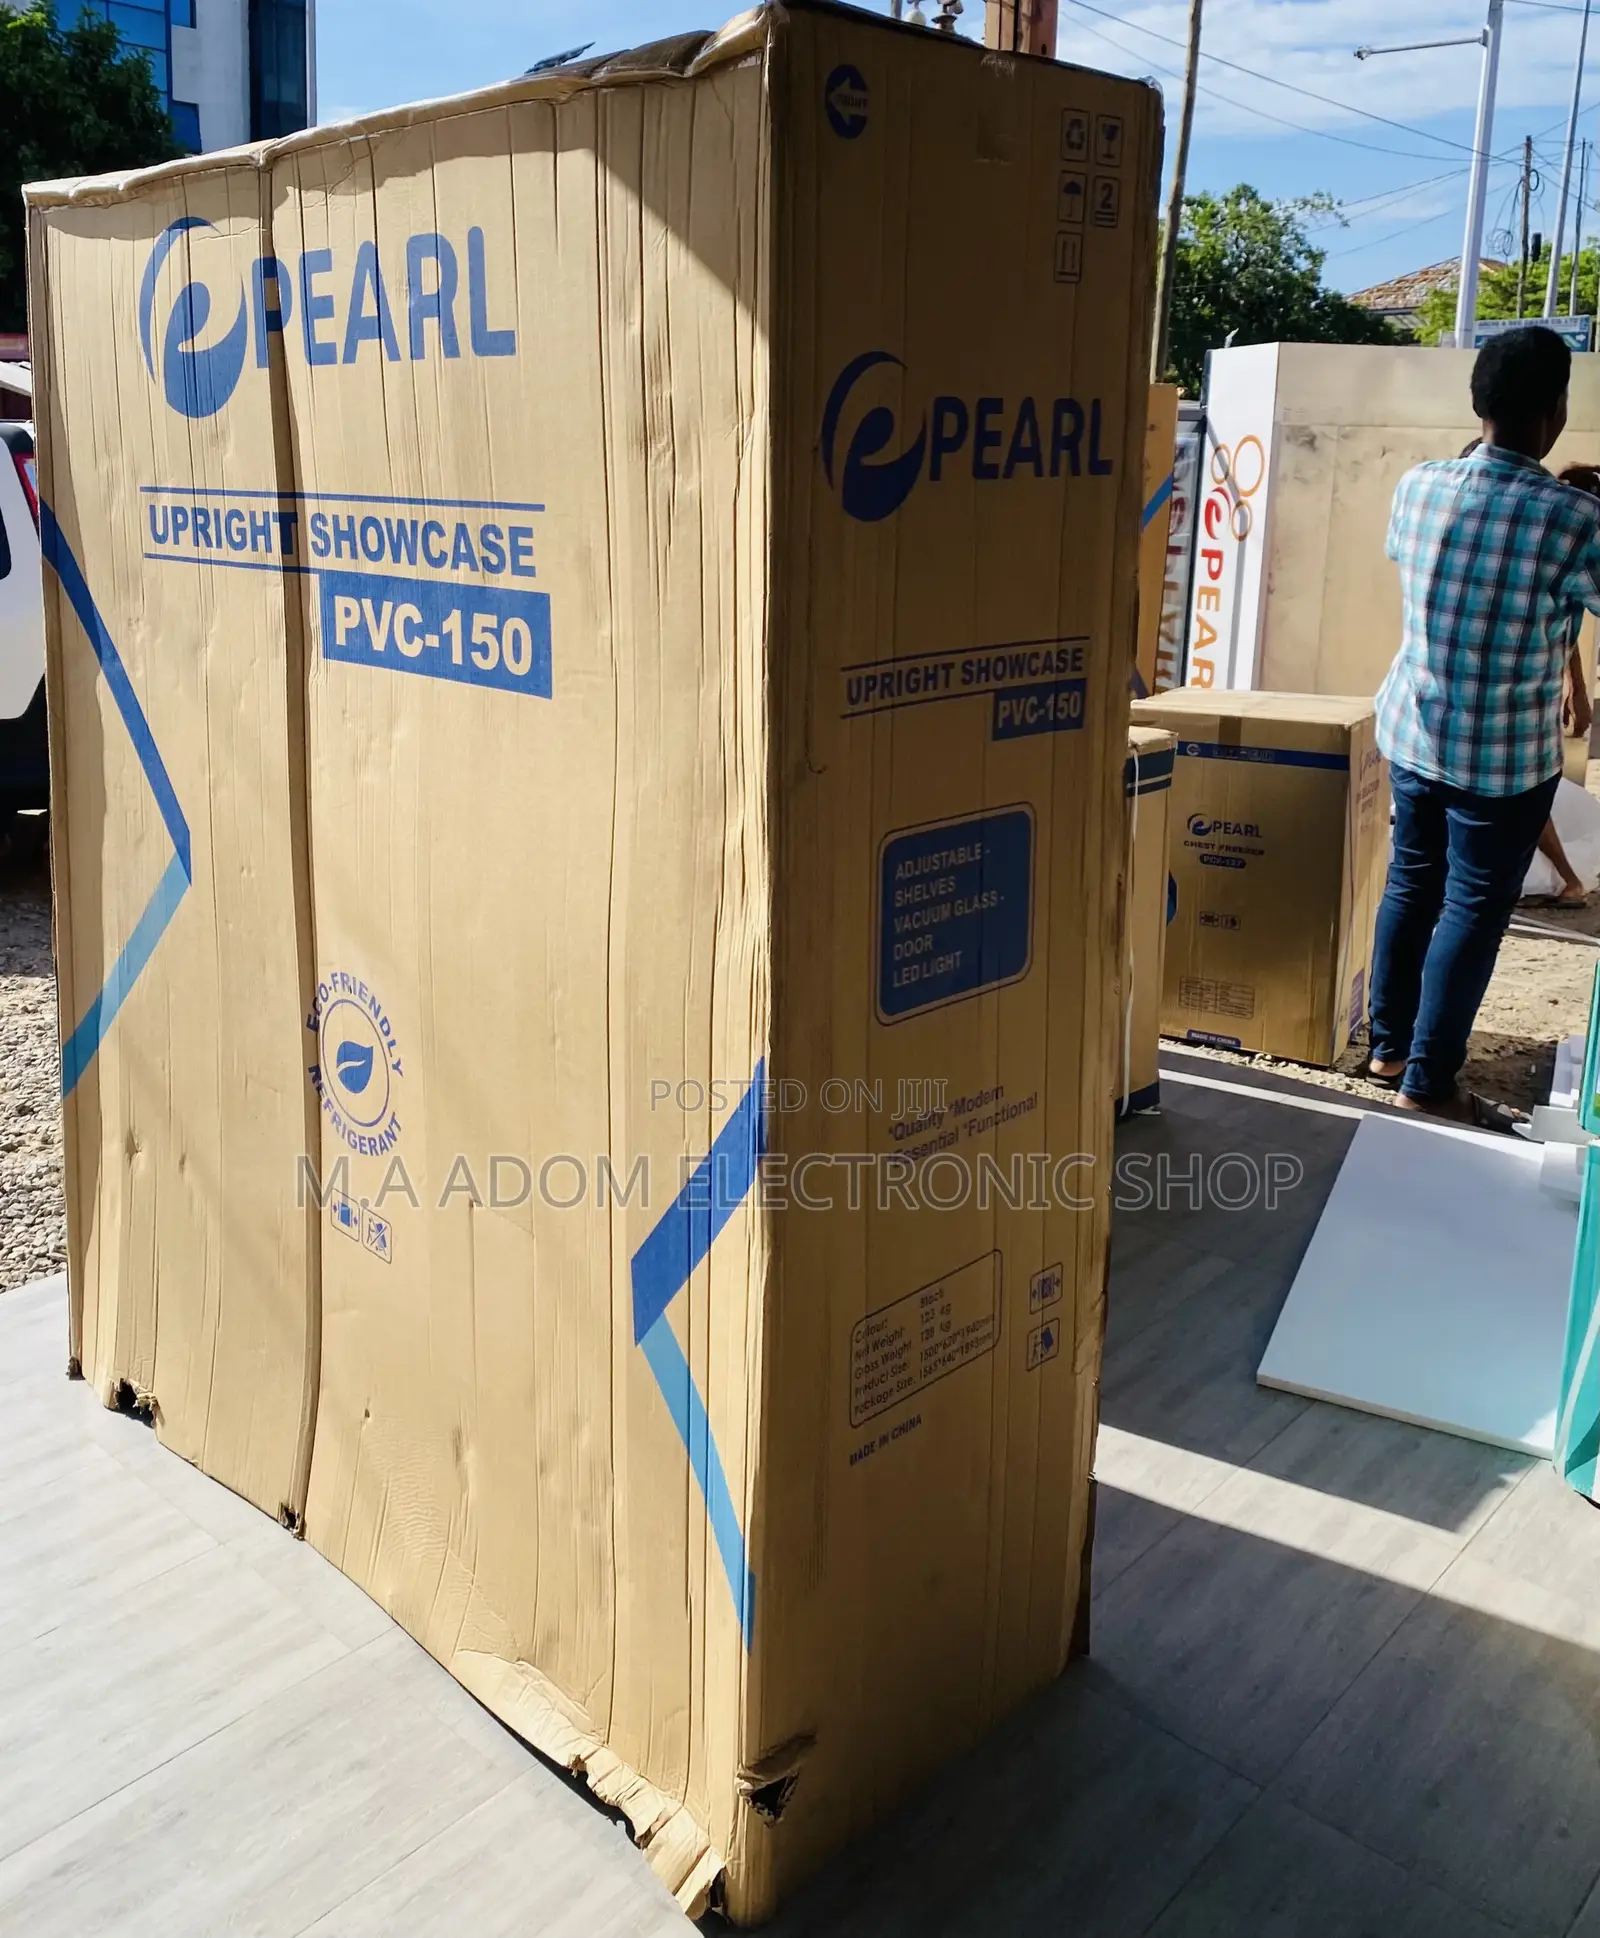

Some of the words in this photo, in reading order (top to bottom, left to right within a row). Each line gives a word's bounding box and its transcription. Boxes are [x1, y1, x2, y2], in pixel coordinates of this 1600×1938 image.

[251, 226, 517, 369] PEARL
[929, 396, 1113, 482] PEARL
[150, 505, 298, 556] UPRIGHT
[310, 512, 537, 579] SHOWCASE
[334, 595, 533, 676] PVC-150
[846, 663, 953, 706] UPRIGHT
[961, 647, 1085, 686] SHOWCASE
[998, 690, 1082, 730] PVC-150
[1183, 840, 1216, 850] CHEST
[1212, 820, 1263, 838] PEARL
[895, 843, 983, 880] ADJUSTABLE
[893, 902, 952, 935] VACUUM
[953, 889, 999, 917] GLASS
[894, 875, 957, 908] SHELVES
[892, 964, 921, 989] LED
[922, 950, 963, 978] LIGHT
[893, 934, 934, 962] DOOR
[306, 971, 404, 1078] ECO-FRIENDLY
[307, 1063, 403, 1157] REFRIGERANT
[854, 1358, 881, 1381] Gross
[853, 1386, 895, 1416] Package
[849, 1438, 877, 1468] MADE
[878, 1429, 890, 1450] IN
[891, 1413, 923, 1442] CHINA
